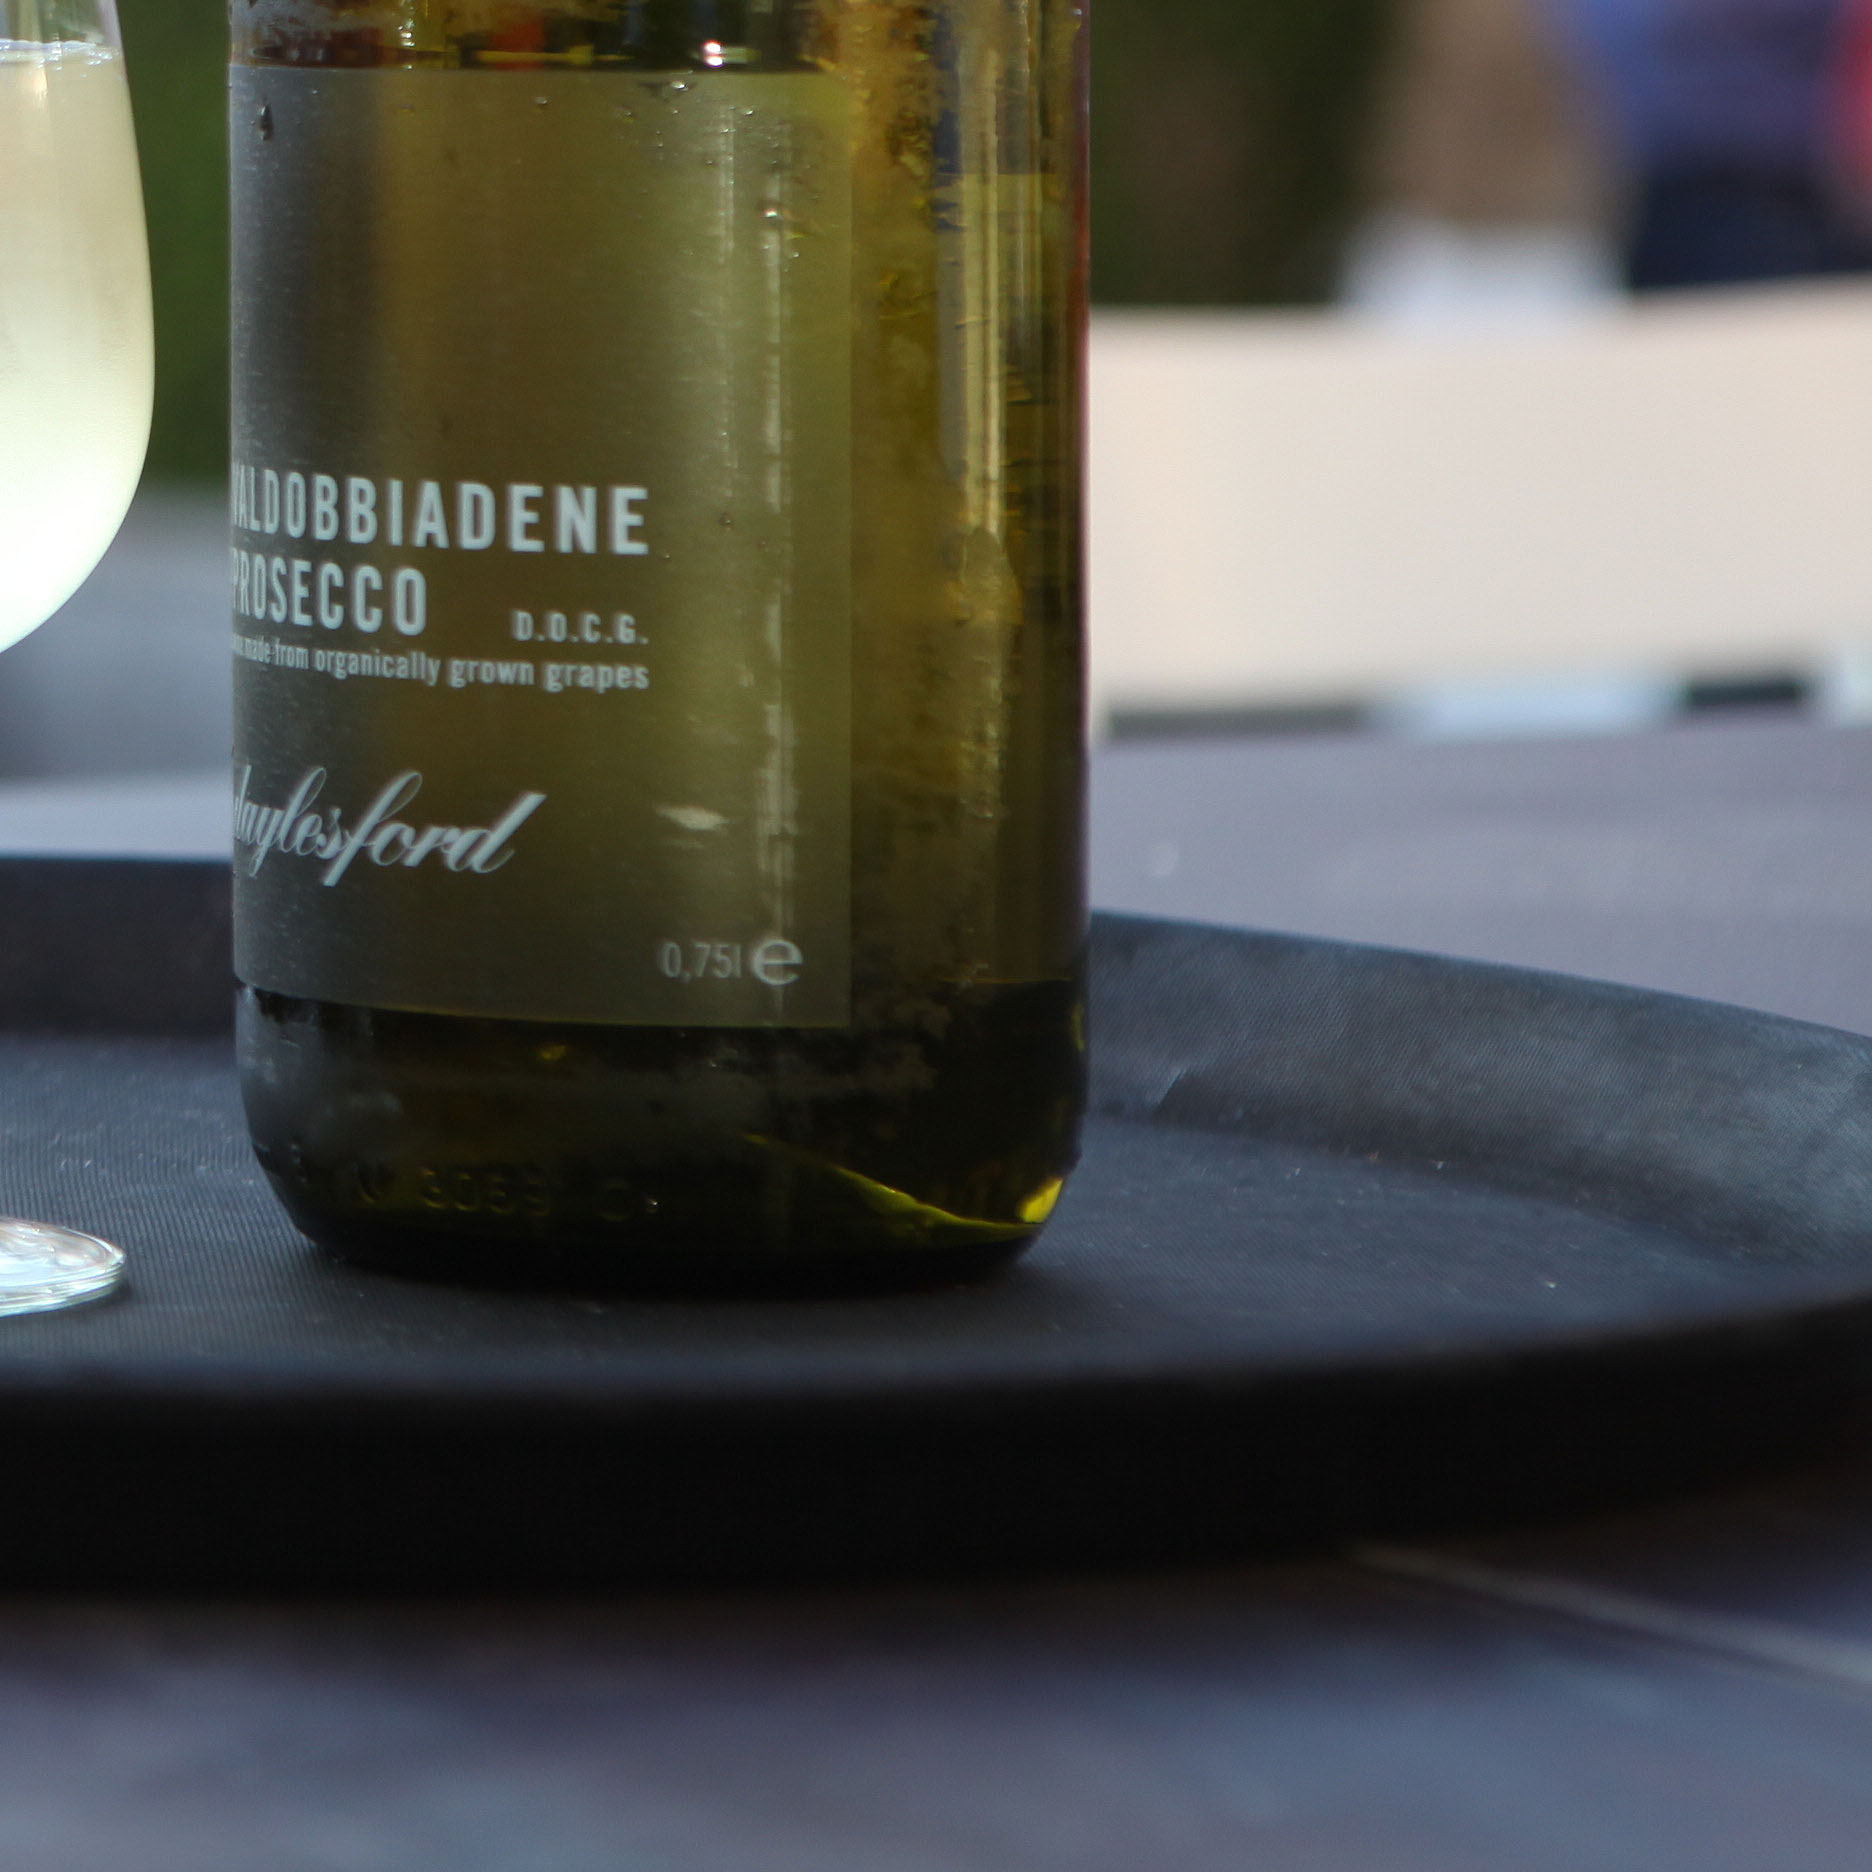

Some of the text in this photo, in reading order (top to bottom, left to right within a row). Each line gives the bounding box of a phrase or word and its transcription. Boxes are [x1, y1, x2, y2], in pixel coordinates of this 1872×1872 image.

[512, 608, 650, 646] D.O.C.G.
[272, 636, 309, 670] from
[313, 647, 441, 688] organically
[447, 657, 536, 690] grown
[543, 660, 650, 694] grapes
